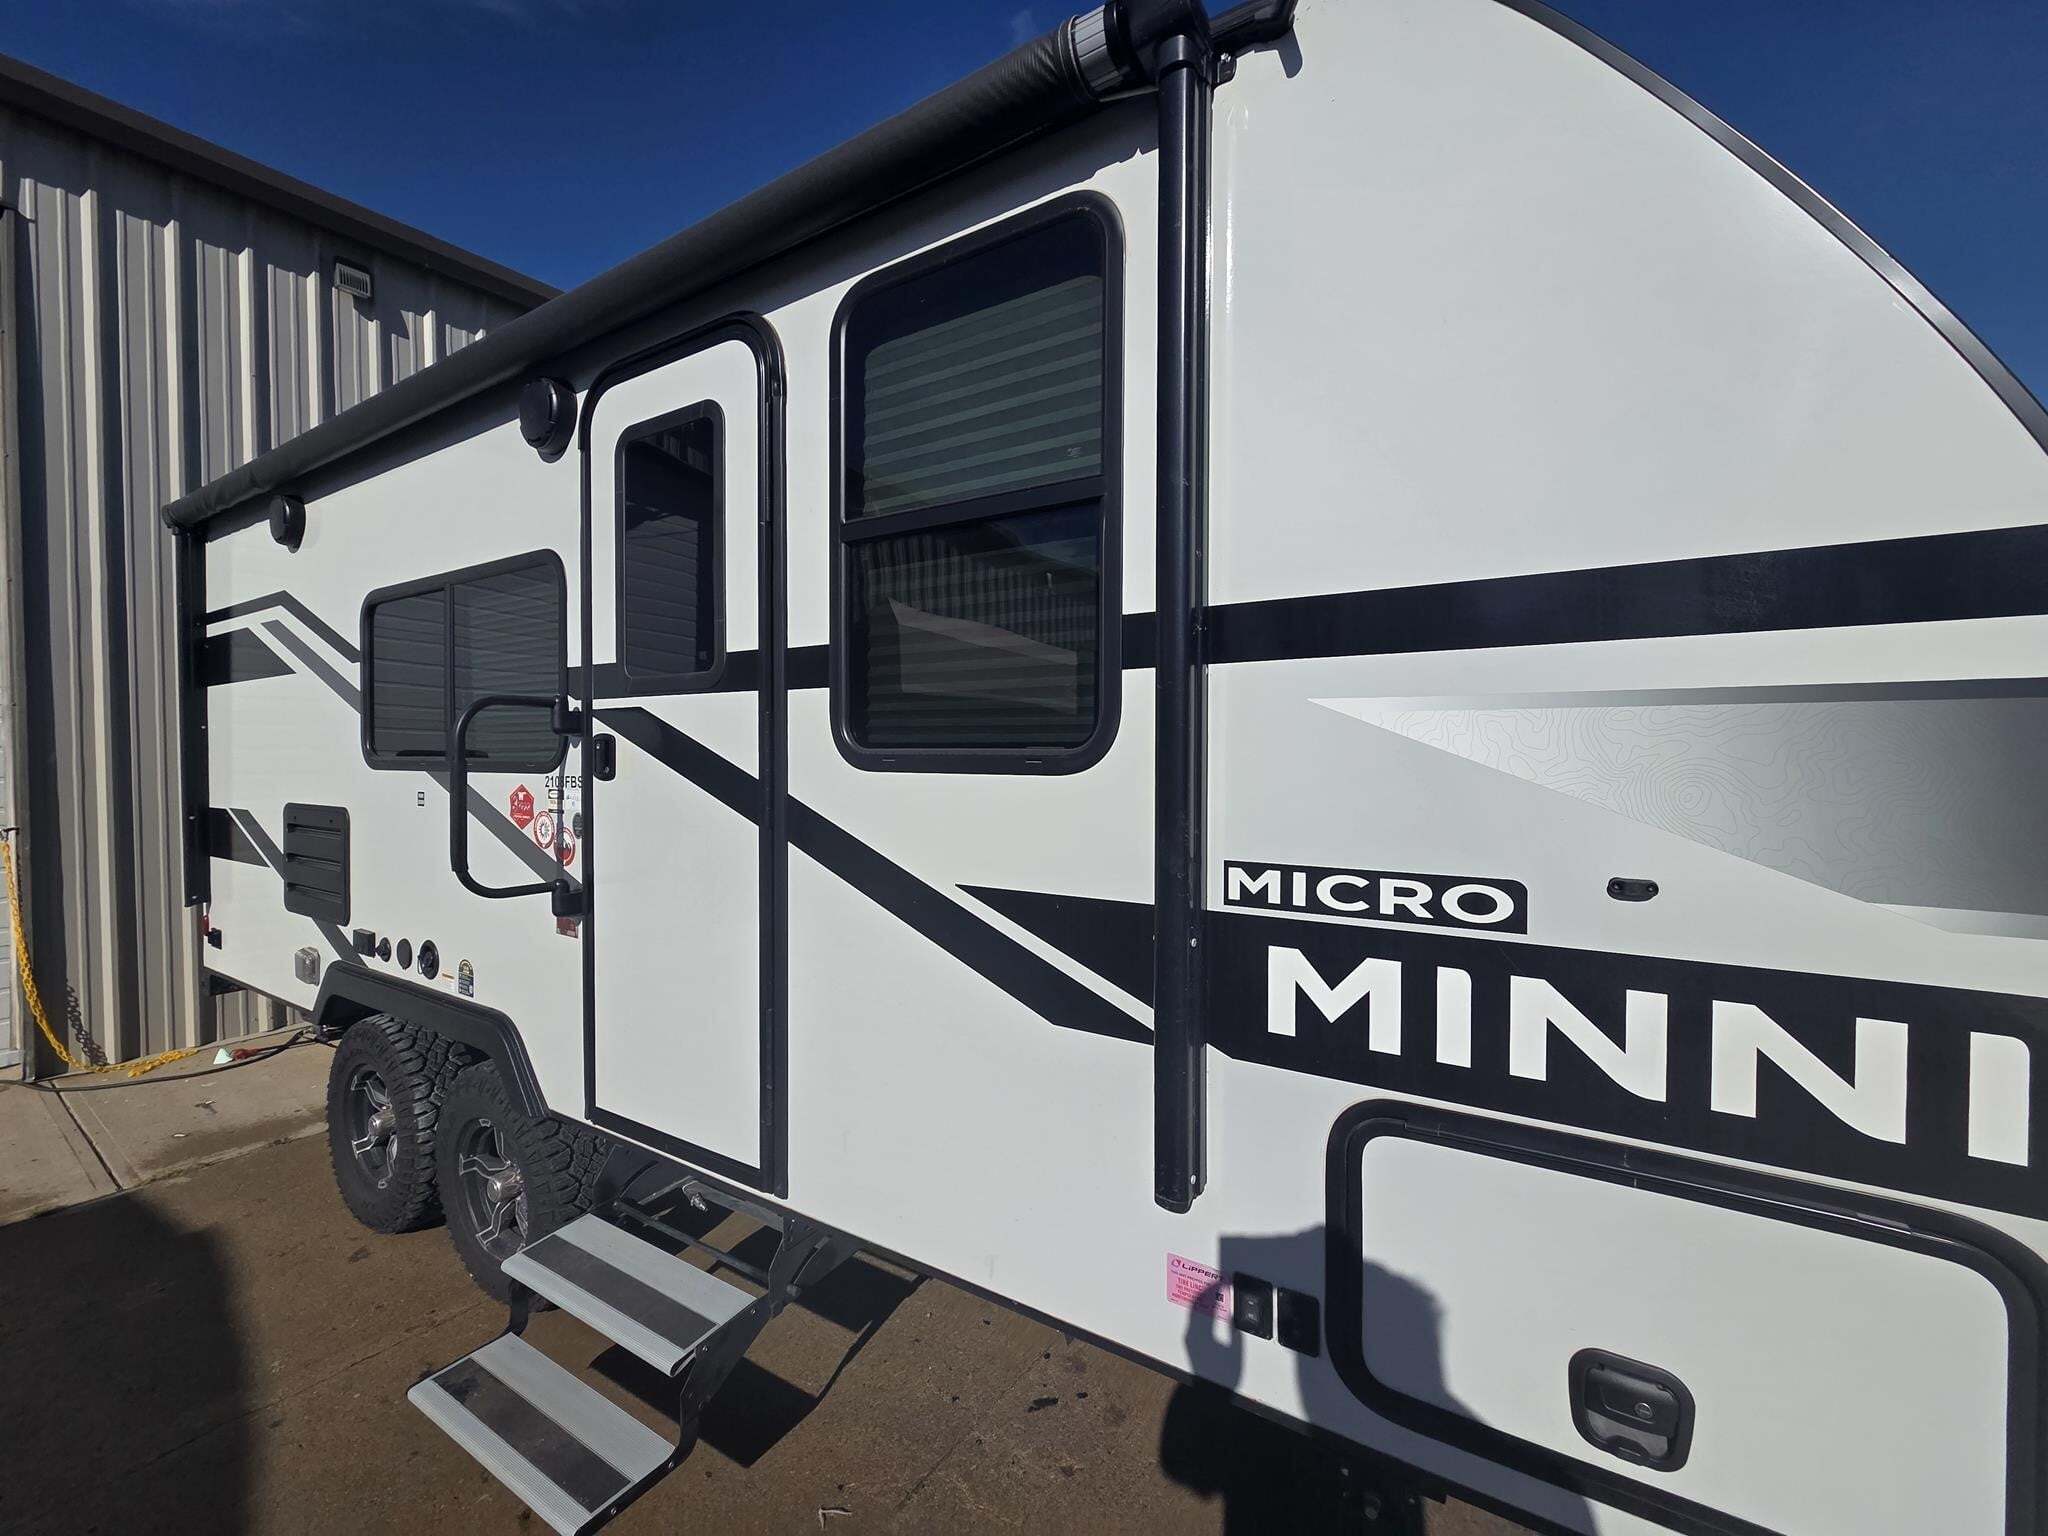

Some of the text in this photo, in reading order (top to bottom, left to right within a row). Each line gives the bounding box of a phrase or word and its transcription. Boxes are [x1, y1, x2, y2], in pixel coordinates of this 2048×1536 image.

[545, 775, 582, 789] 210FBS
[1227, 868, 1515, 925] MICRO
[1268, 945, 2031, 1167] MINNI
